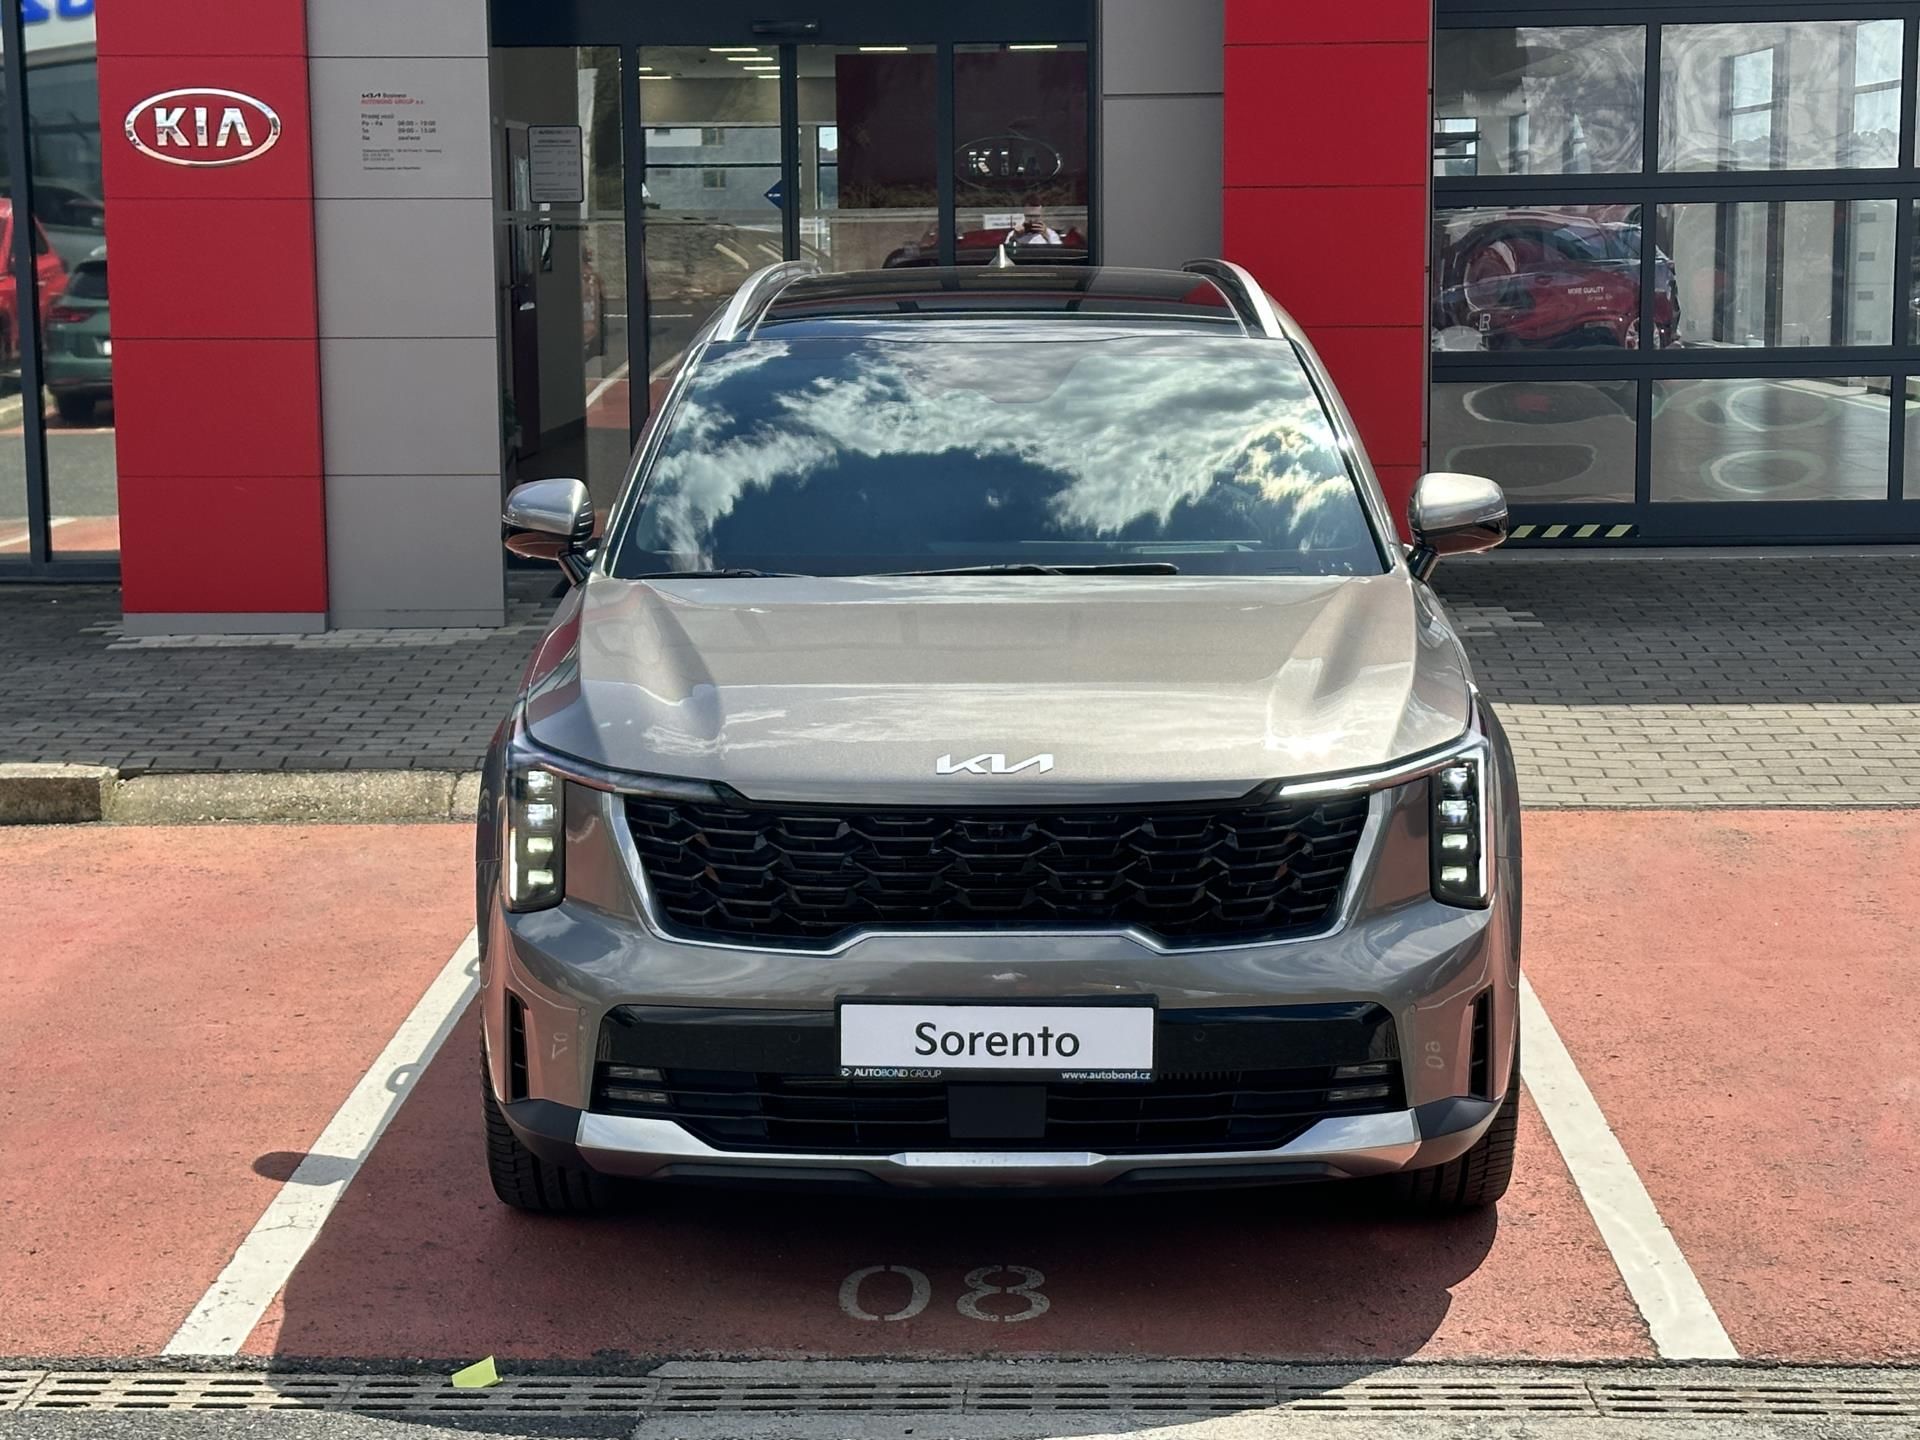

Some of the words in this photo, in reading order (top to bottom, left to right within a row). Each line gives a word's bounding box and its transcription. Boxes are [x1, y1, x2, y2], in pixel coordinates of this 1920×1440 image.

[154, 106, 253, 147] KIA
[915, 1021, 1080, 1057] Sorento
[853, 1067, 908, 1077] AUTOBOND
[909, 1069, 942, 1078] GROUP
[1061, 1070, 1151, 1080] www.autobond.cz
[838, 1265, 1051, 1322] 08
